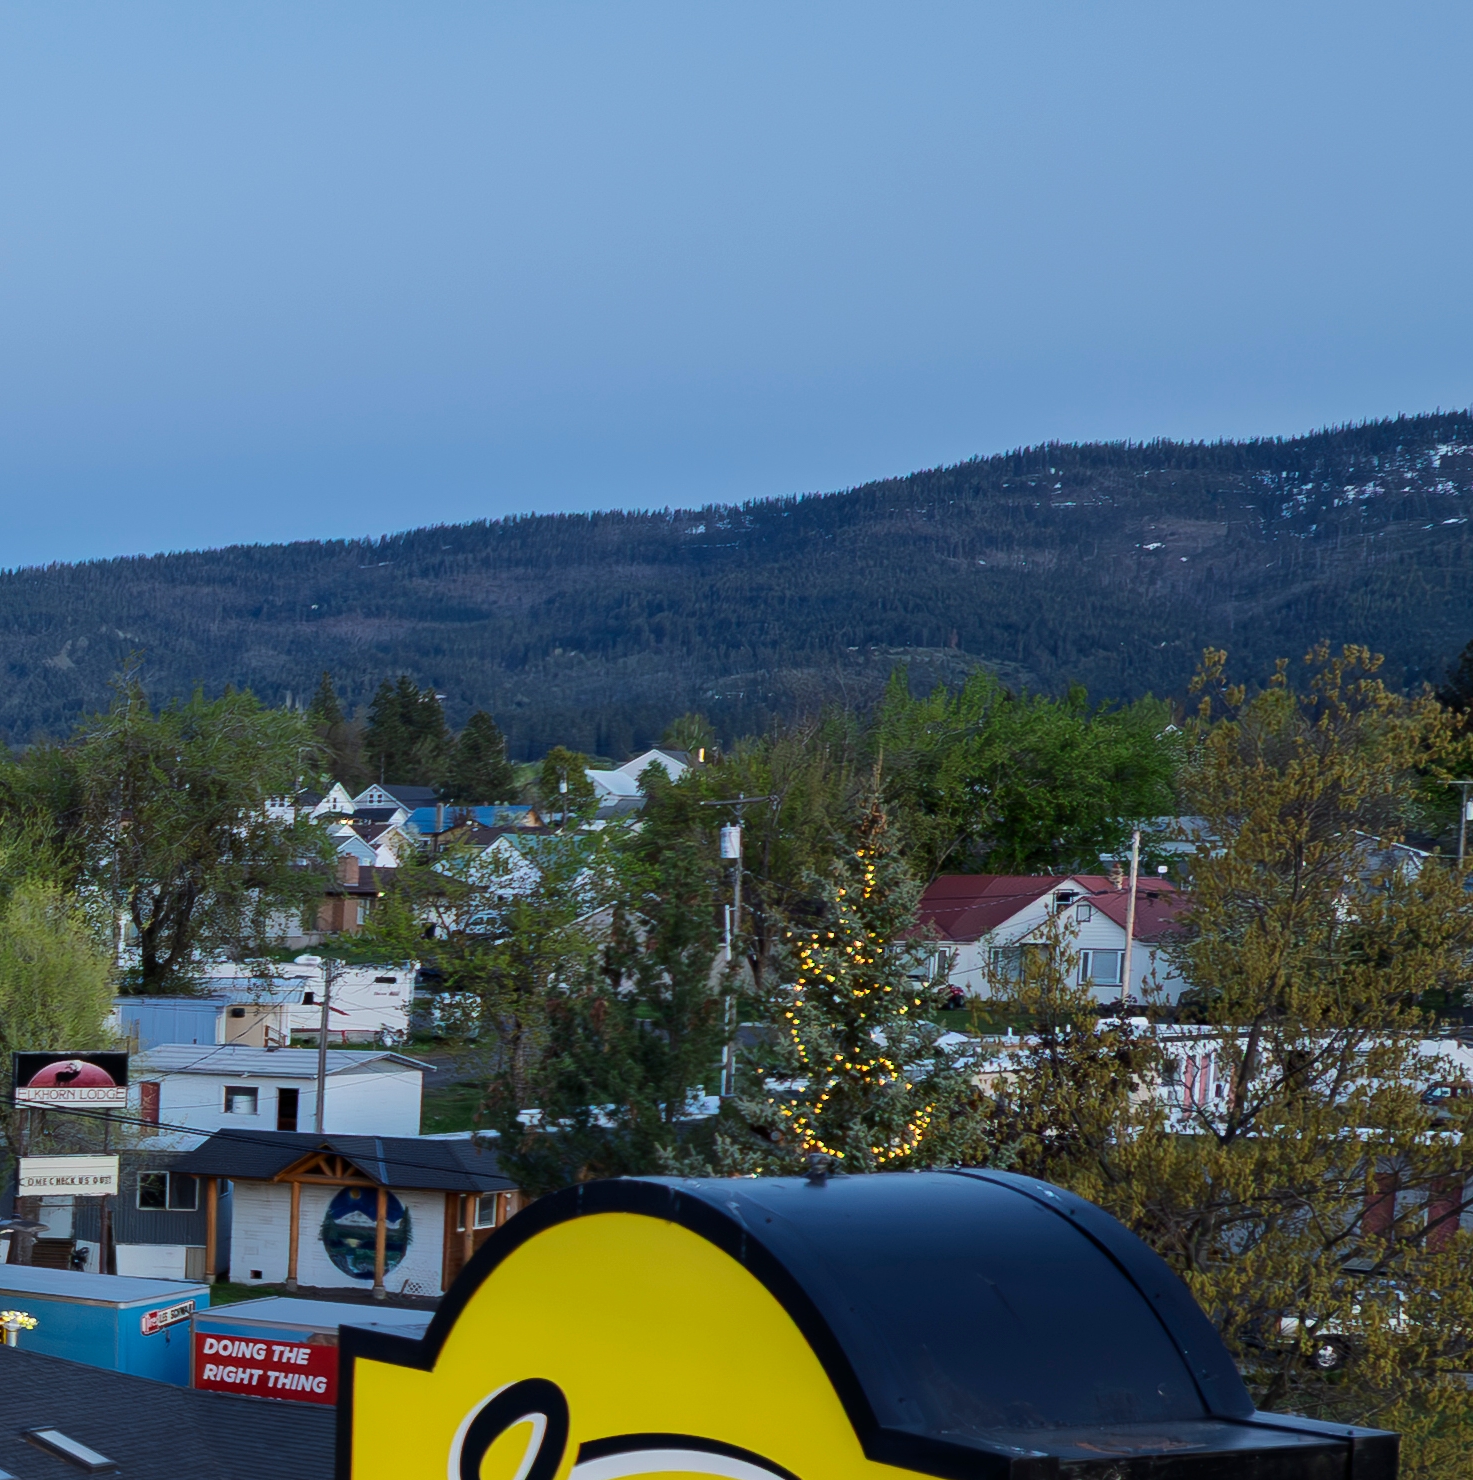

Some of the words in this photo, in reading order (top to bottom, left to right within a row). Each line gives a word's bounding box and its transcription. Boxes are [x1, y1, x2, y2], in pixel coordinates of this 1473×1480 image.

[18, 1088, 76, 1100] ELKHORN
[80, 1087, 126, 1100] LODGE
[203, 1337, 267, 1361] DOING
[271, 1344, 312, 1366] THE
[203, 1364, 263, 1385] RIGHT
[267, 1371, 327, 1393] THING
